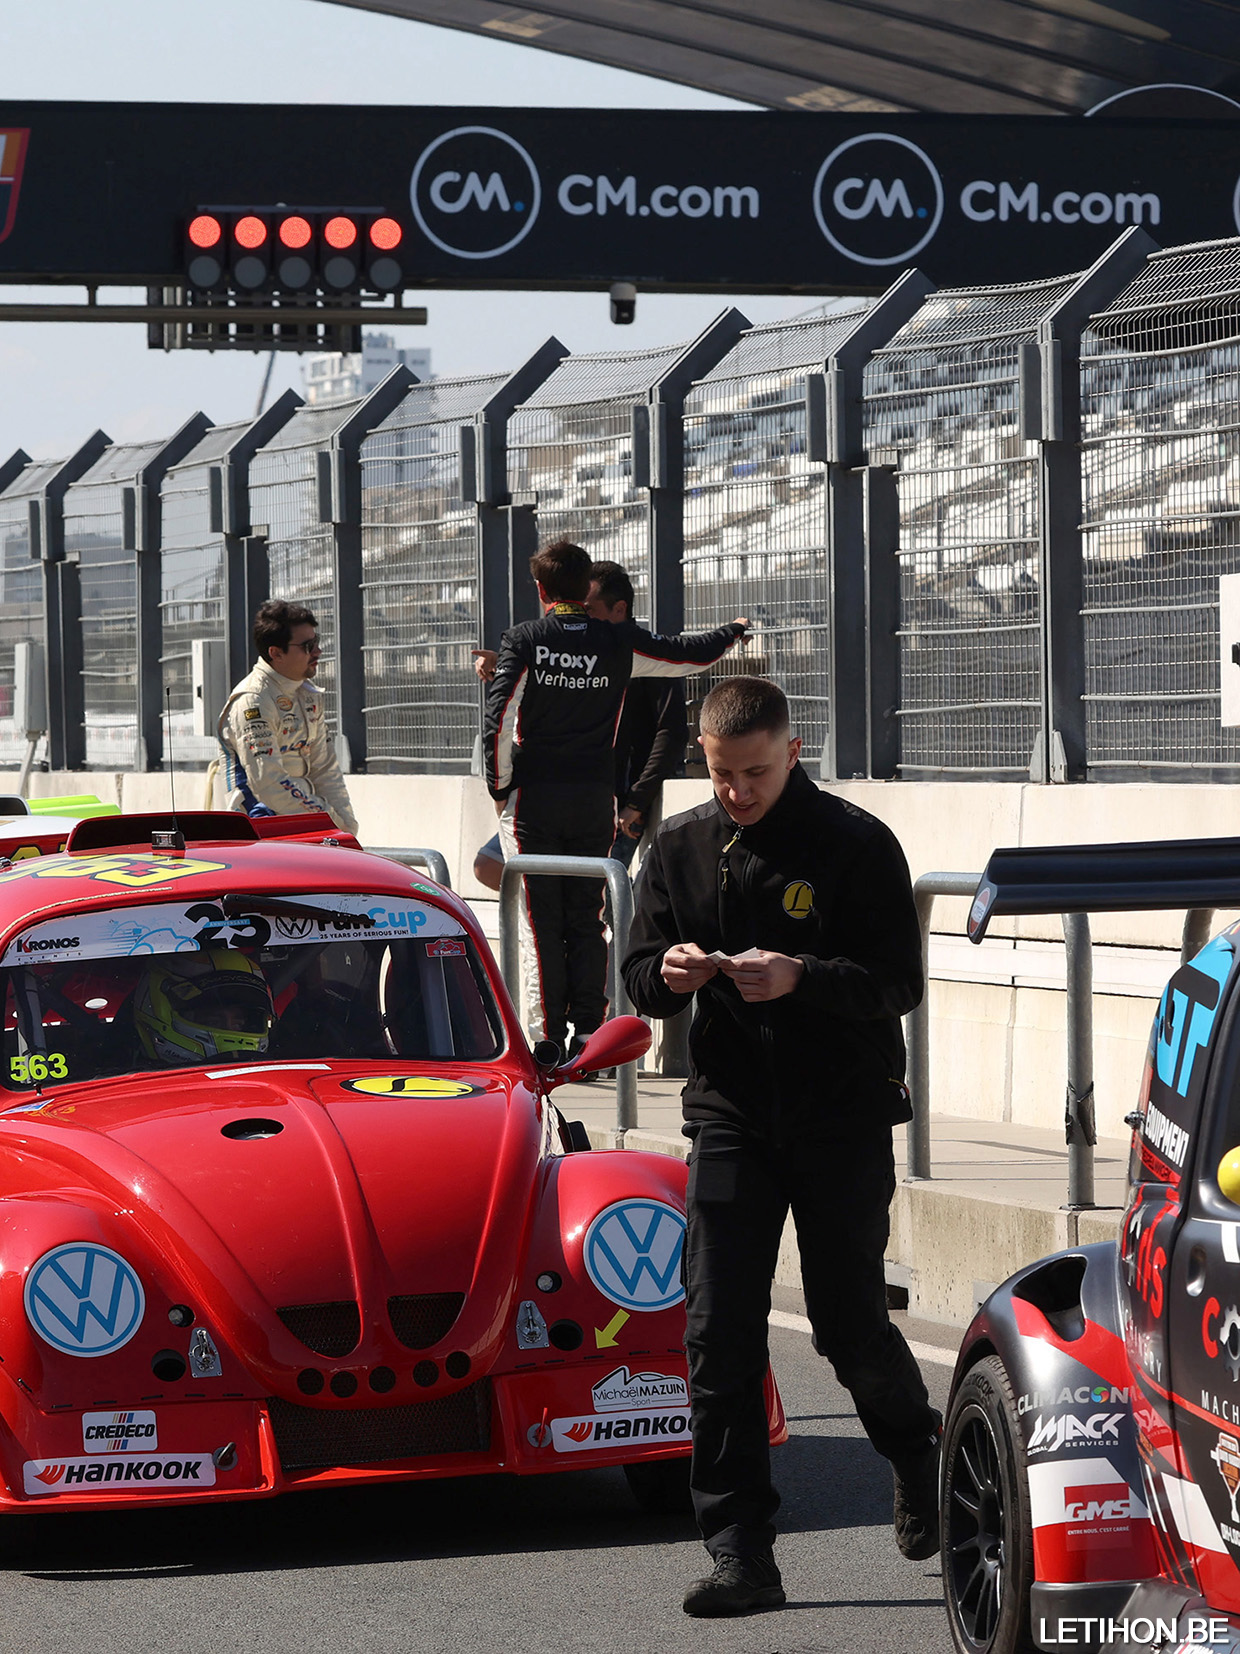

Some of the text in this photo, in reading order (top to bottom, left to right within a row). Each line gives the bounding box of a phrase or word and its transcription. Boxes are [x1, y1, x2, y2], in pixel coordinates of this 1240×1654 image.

[557, 173, 760, 219] CM.com
[959, 180, 1161, 225] CM.com
[535, 645, 598, 675] Proxy
[534, 669, 609, 690] Verhaeren
[16, 935, 80, 953] KRONOS
[330, 932, 354, 940] YEARS
[10, 1052, 68, 1082] 563
[1144, 1100, 1190, 1168] EQUIPMENT
[631, 1398, 651, 1407] Sport
[84, 1423, 156, 1440] CREDECO
[1027, 1445, 1049, 1456] GLOBAL
[1065, 1440, 1119, 1448] SERVICES
[64, 1460, 202, 1484] HANKOOK
[1066, 1499, 1131, 1521] GMS
